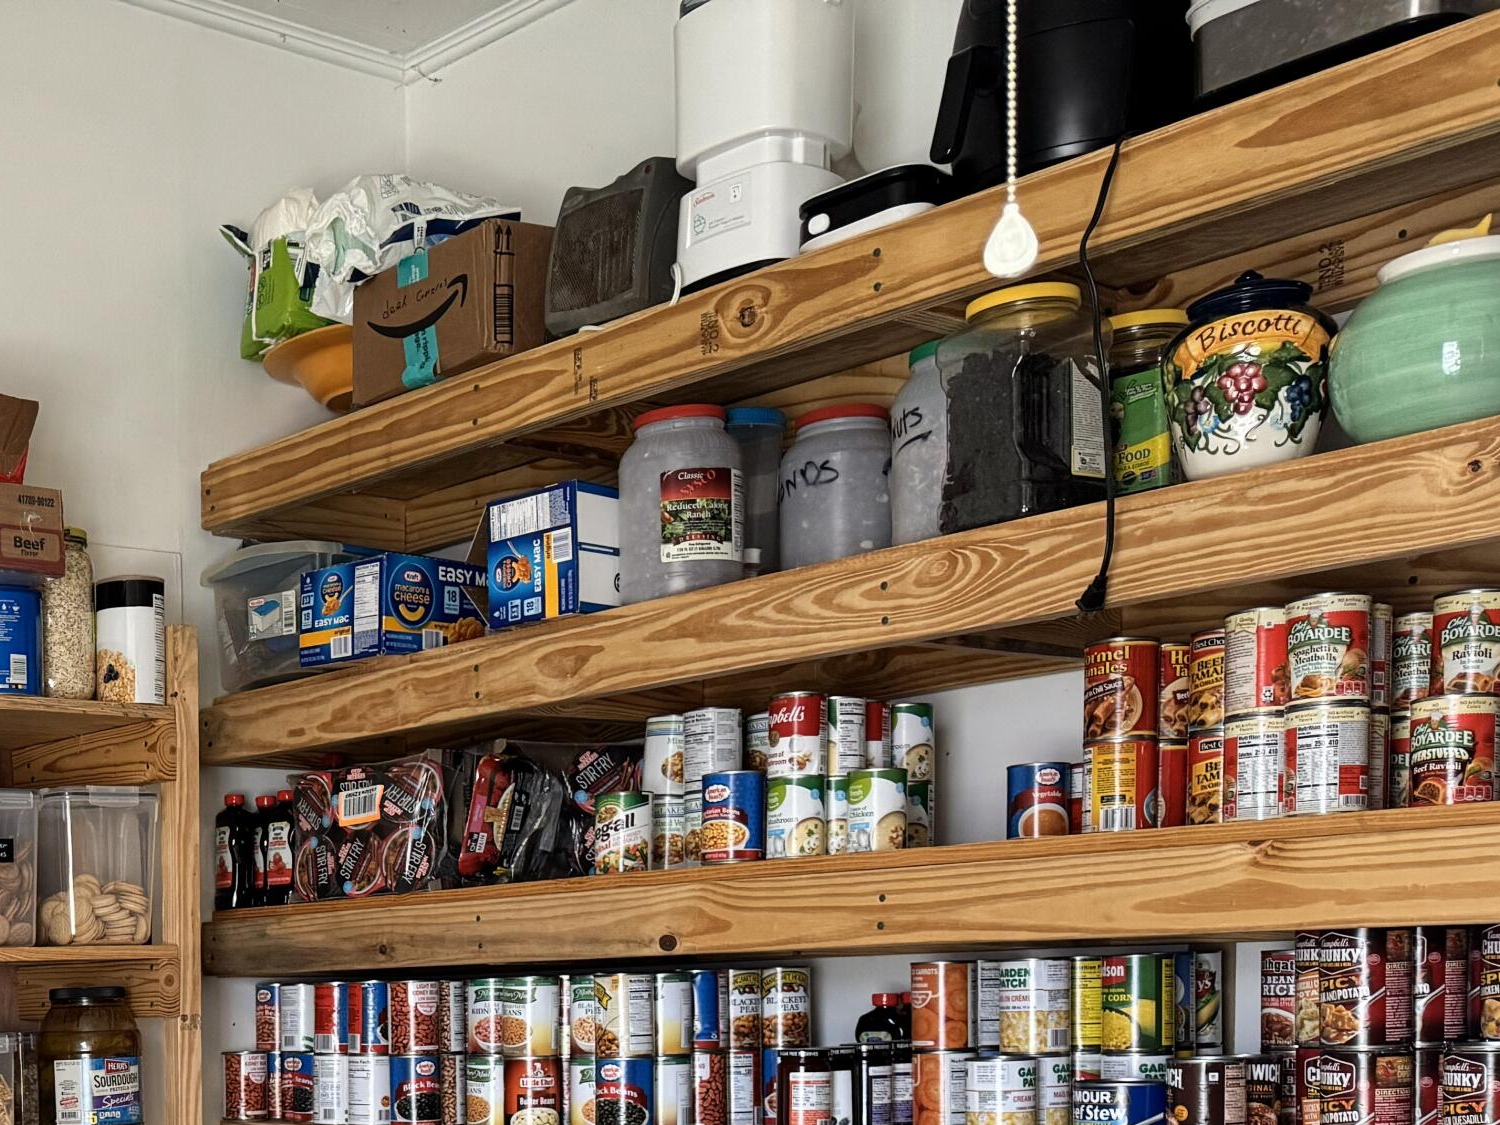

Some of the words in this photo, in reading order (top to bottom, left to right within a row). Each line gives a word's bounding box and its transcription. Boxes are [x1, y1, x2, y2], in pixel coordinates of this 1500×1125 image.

[1196, 313, 1303, 352] Biscotti
[1118, 447, 1151, 464] FOOD
[677, 471, 704, 480] Classic
[13, 536, 46, 550] Beef
[394, 584, 425, 593] macaroni
[447, 590, 458, 603] 18
[1291, 620, 1308, 634] Chef
[1288, 627, 1351, 646] BOYARDEE
[1292, 646, 1332, 661] Spaghetti
[1294, 654, 1337, 666] Meatballs
[1452, 649, 1493, 661] Ravioli
[1411, 730, 1475, 748] BOYARDEE
[93, 1072, 138, 1089] SOURDOUGH
[1085, 1105, 1126, 1120] Stew
